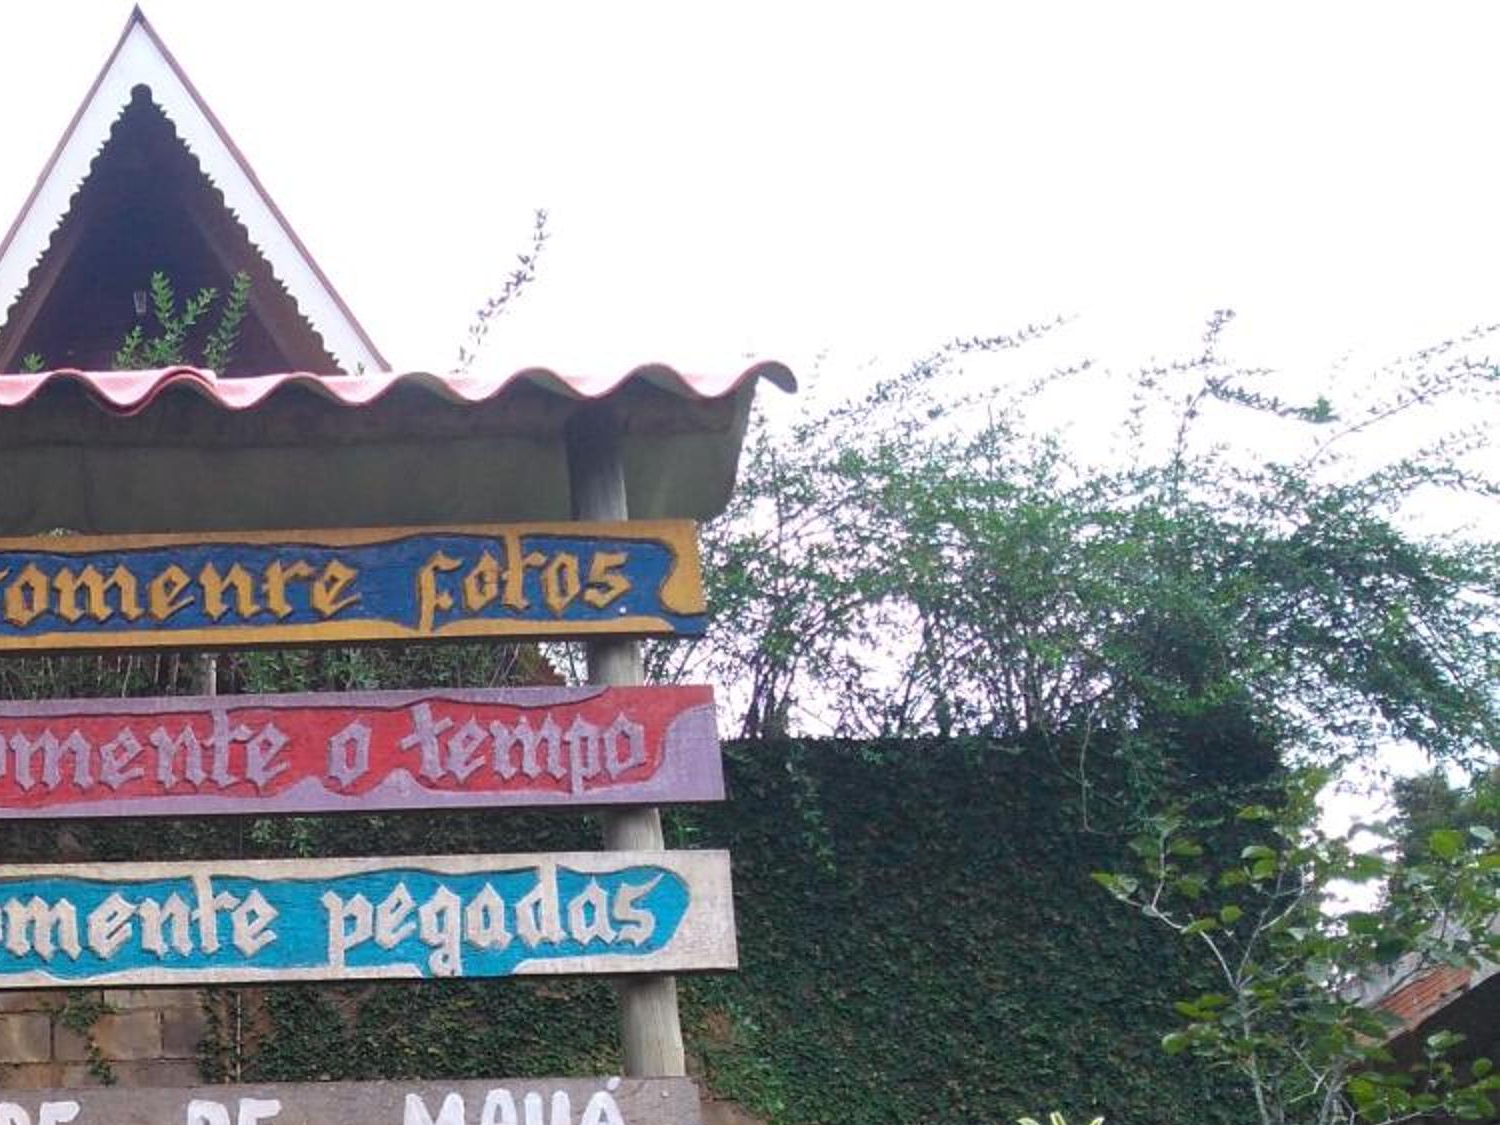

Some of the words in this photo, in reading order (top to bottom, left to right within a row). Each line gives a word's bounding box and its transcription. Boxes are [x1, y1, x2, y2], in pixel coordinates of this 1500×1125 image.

[417, 530, 632, 634] fotos
[328, 718, 372, 787] o
[400, 702, 646, 796] tempo
[321, 866, 665, 976] pegadas
